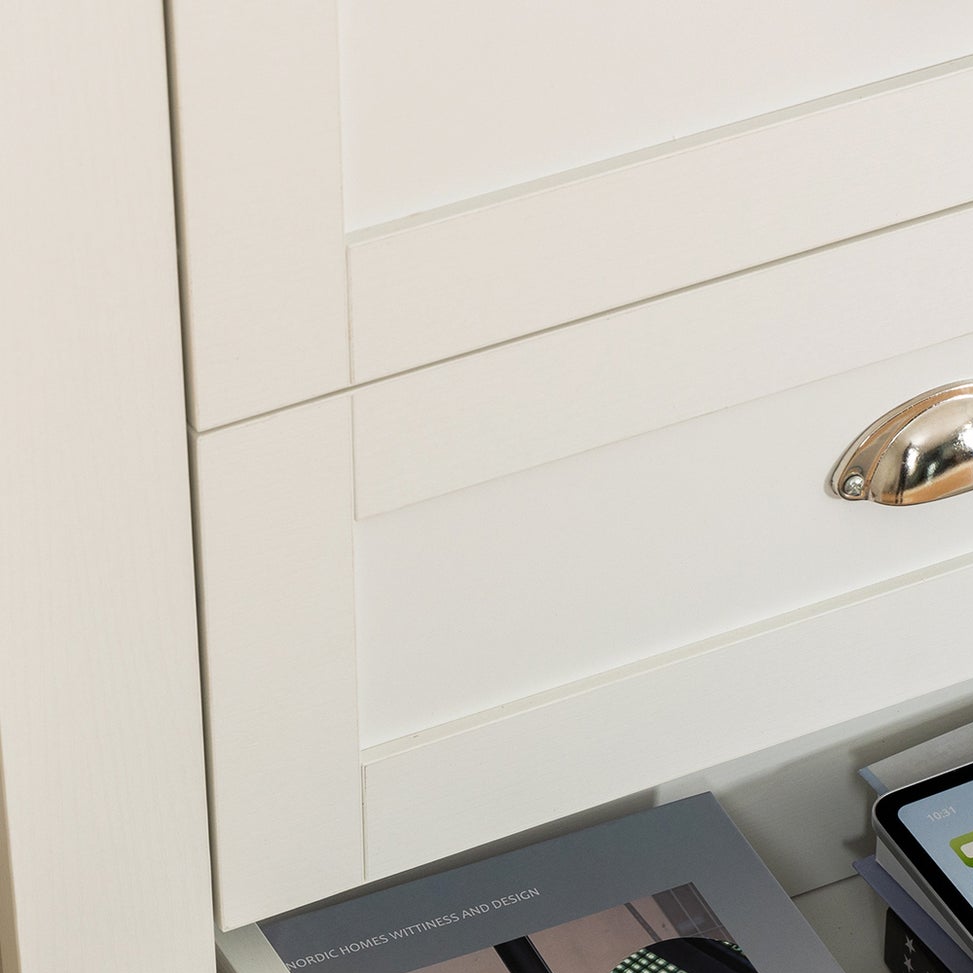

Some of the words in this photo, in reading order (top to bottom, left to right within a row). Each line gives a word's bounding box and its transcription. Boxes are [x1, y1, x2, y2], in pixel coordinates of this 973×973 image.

[927, 806, 957, 823] 10:31
[285, 948, 340, 970] NORDIC
[339, 934, 390, 956] HOMES
[388, 912, 460, 940] WITTINESS
[462, 903, 490, 920] AND
[491, 887, 540, 910] DESIGN
